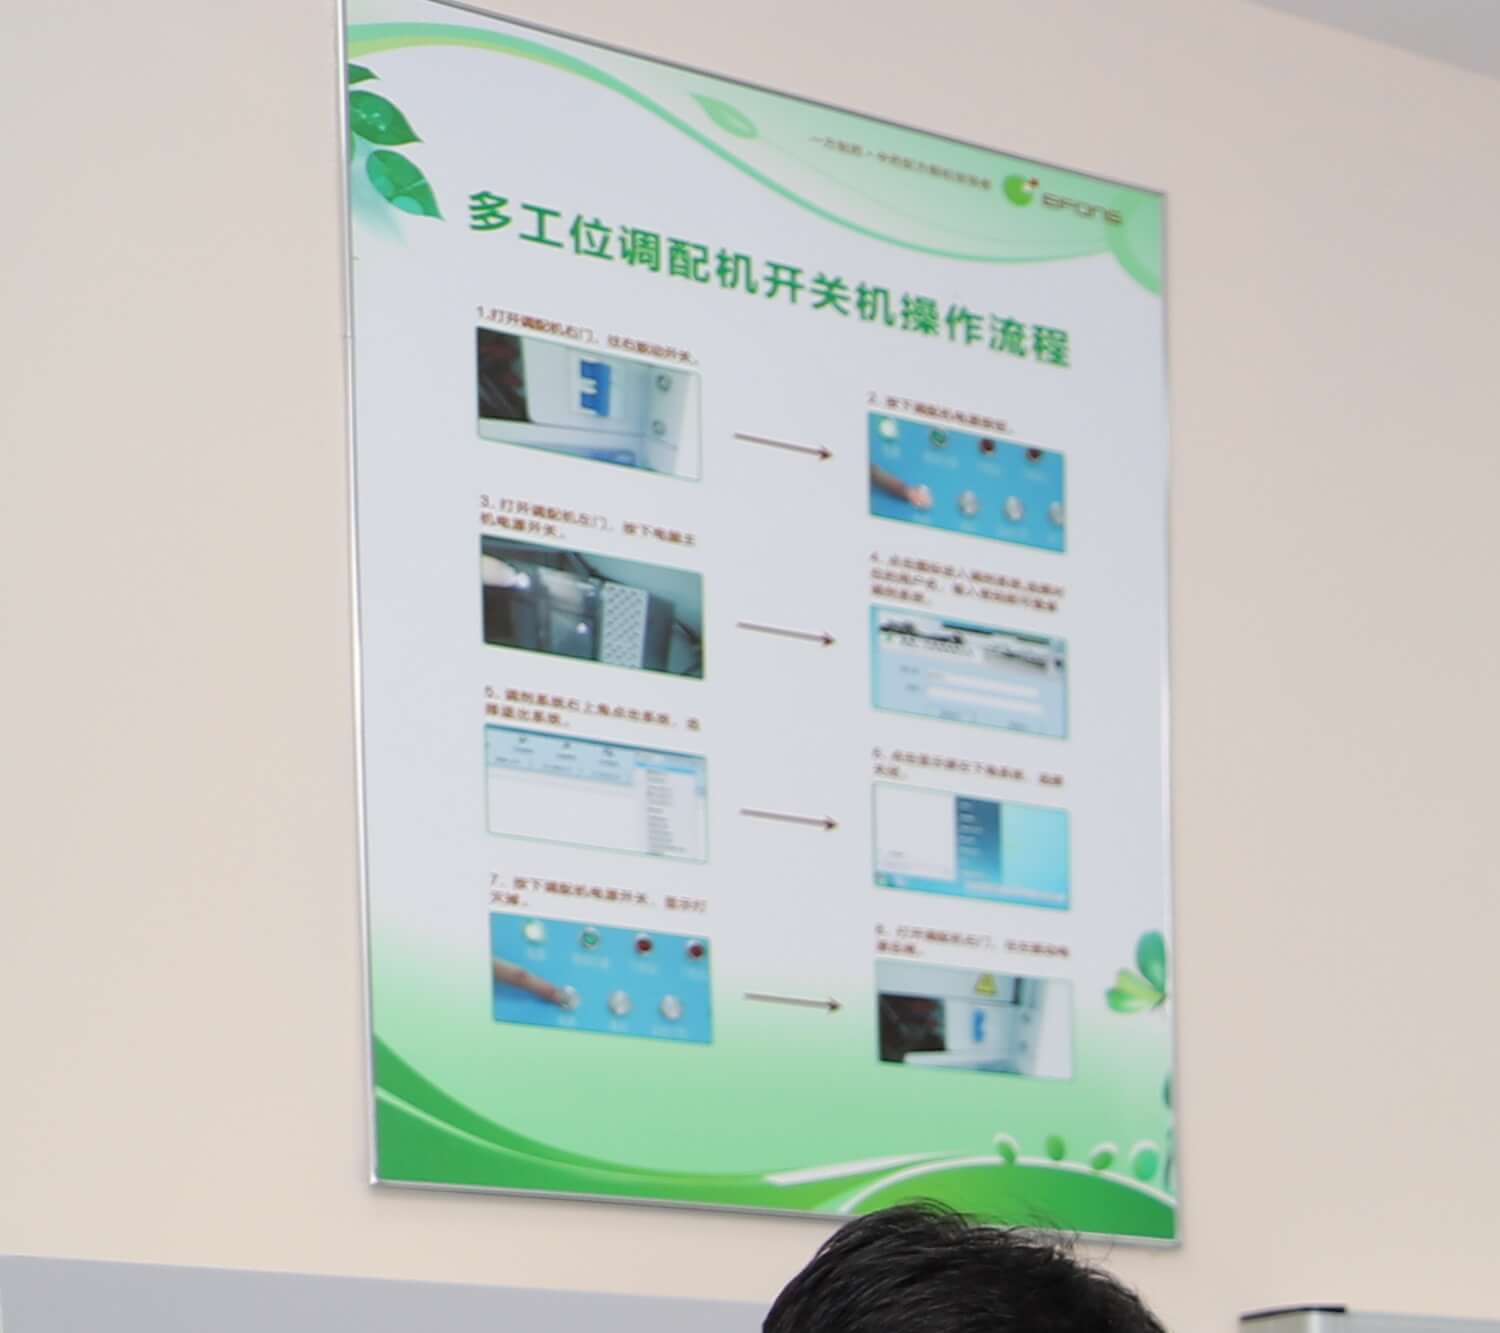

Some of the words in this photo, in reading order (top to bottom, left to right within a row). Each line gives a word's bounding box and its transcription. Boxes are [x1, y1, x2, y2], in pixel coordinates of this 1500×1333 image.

[466, 189, 1073, 369] 多工位调配机开关机操作流程
